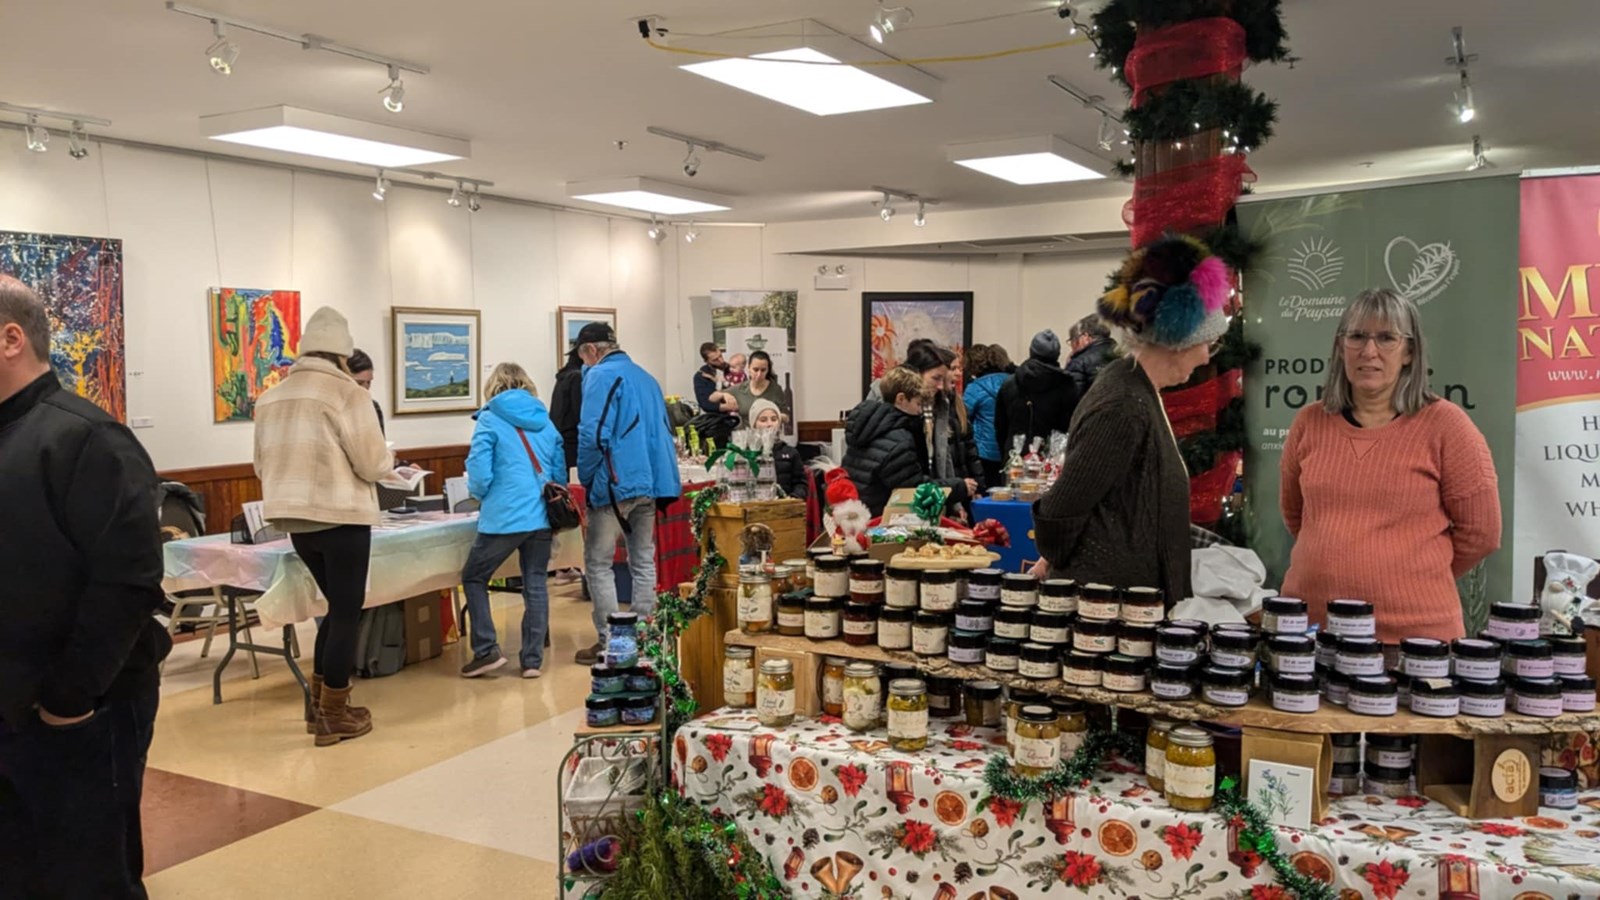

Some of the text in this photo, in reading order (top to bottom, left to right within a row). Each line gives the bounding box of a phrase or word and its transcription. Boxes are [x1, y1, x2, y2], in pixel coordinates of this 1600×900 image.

[1518, 264, 1600, 321] M
[1289, 294, 1346, 308] Domaine
[1281, 308, 1293, 318] du
[1265, 358, 1330, 375] PROD
[1548, 368, 1600, 381] www.
[1263, 428, 1276, 436] au
